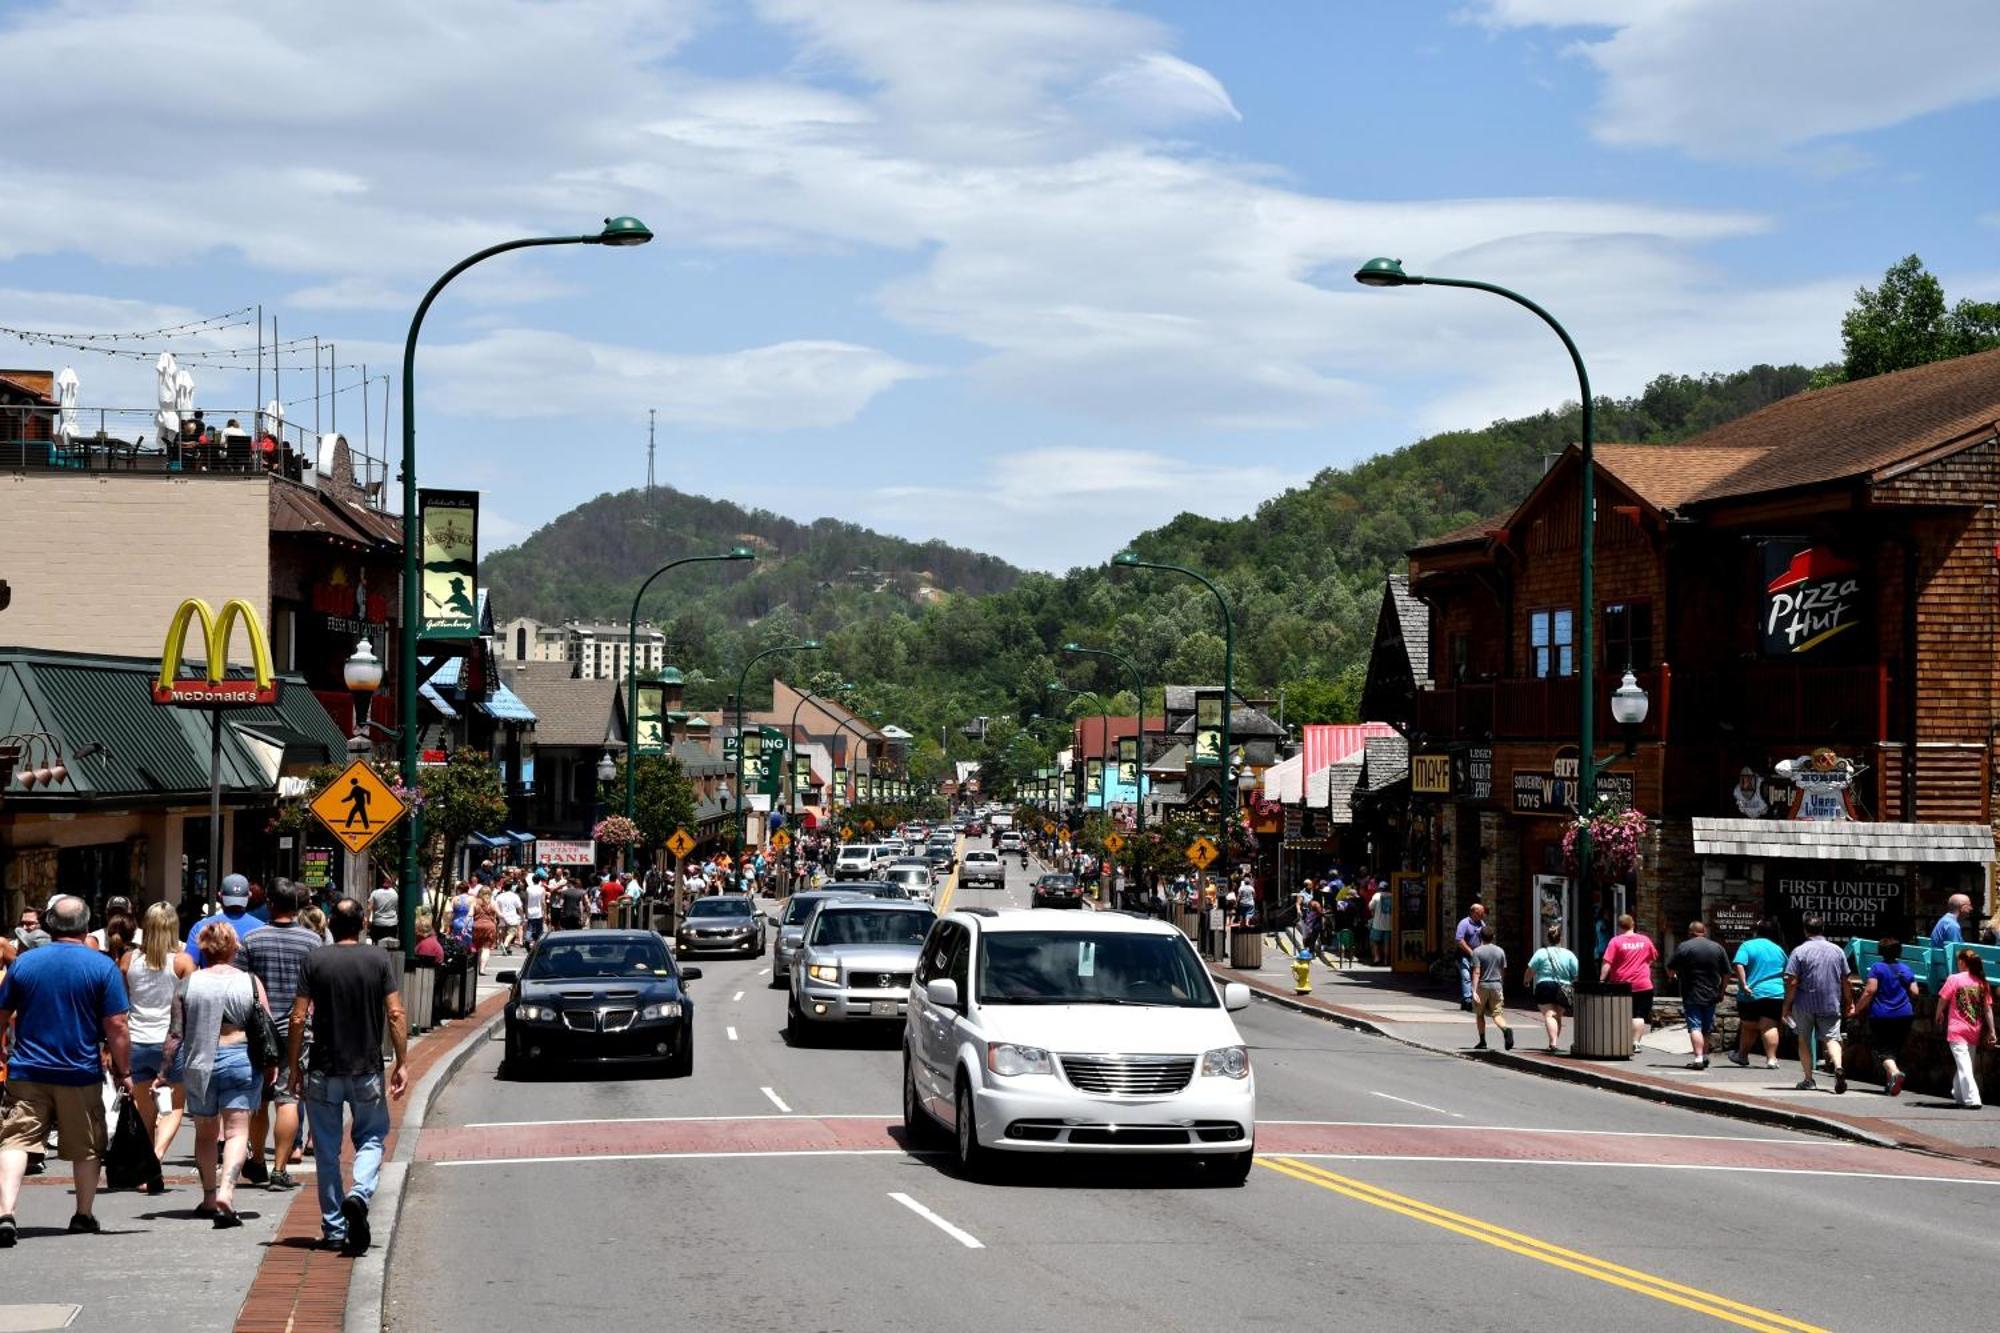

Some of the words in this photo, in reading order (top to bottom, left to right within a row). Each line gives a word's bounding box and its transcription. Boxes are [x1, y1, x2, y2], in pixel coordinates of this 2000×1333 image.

[1768, 579, 1860, 635] Pizza
[426, 619, 472, 632] Gatlinburg
[1784, 602, 1851, 645] Hut
[171, 690, 257, 703] McDonald's
[1517, 793, 1541, 809] TOYS
[540, 853, 590, 863] BANK
[1778, 879, 1828, 895] FIRST
[1832, 880, 1900, 897] UNITED
[1790, 895, 1889, 913] METHODIST
[1622, 942, 1645, 950] STAFF
